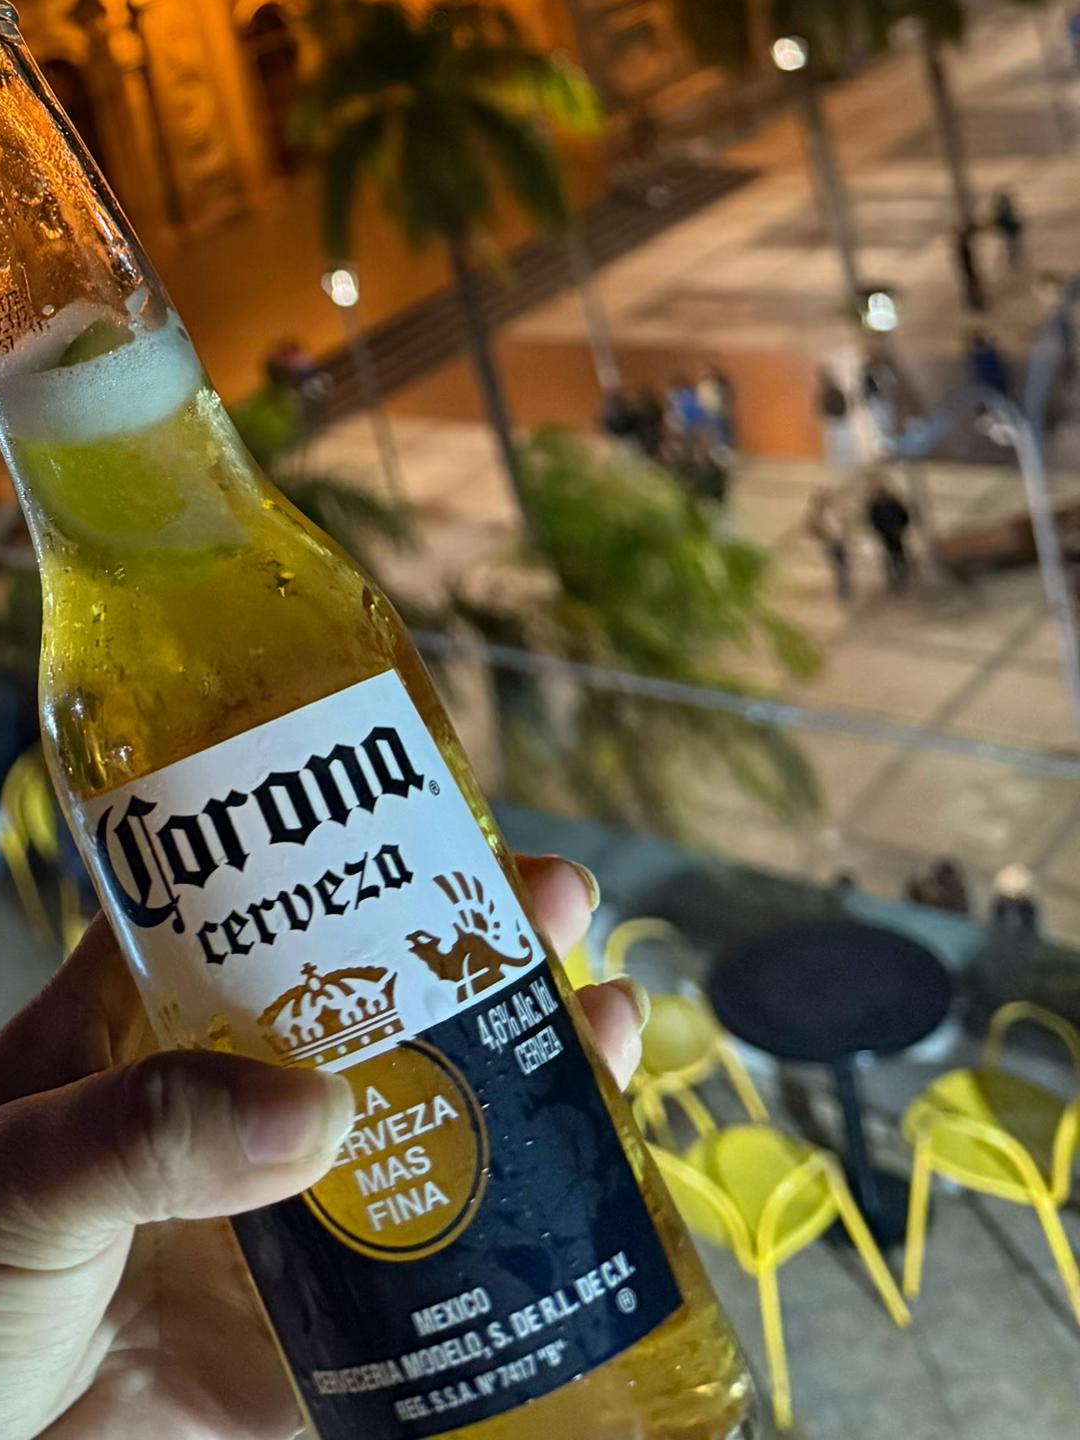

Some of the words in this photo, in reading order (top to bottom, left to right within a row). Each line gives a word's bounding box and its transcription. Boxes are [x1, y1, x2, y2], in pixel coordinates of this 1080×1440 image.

[96, 726, 425, 935] Corona
[195, 844, 414, 965] cerveza
[514, 1024, 564, 1075] CERVEZA
[354, 1146, 432, 1197] MAS
[367, 1180, 451, 1232] FINA
[401, 1331, 494, 1380] MODELO,
[508, 1304, 544, 1339] DE
[573, 1269, 606, 1304] DE
[411, 1286, 491, 1337] MEXICO
